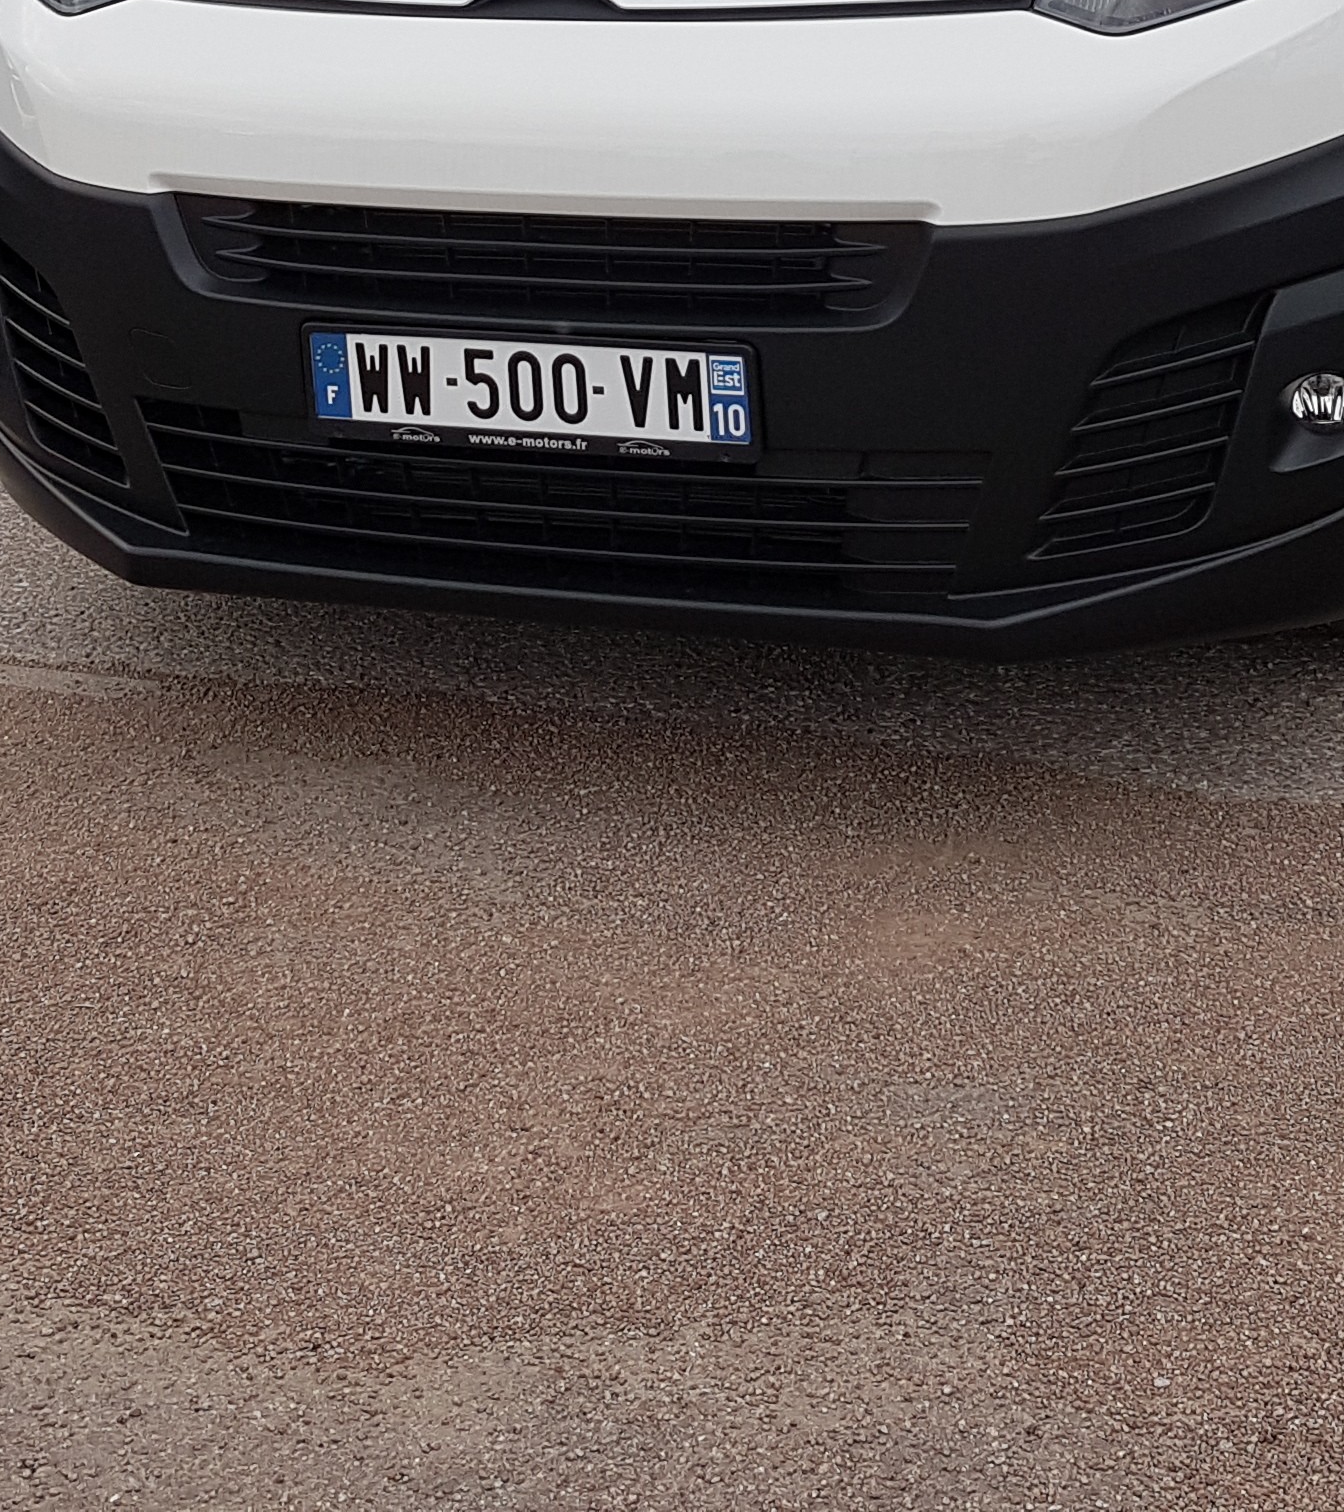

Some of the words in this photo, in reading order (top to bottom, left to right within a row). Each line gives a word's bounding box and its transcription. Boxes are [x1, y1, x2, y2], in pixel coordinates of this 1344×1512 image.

[712, 362, 740, 372] Grand
[354, 342, 704, 432] WW-500-VM
[713, 371, 741, 387] Est
[326, 385, 339, 405] F
[712, 403, 746, 437] 10
[468, 433, 588, 451] www.e-motors.fr
